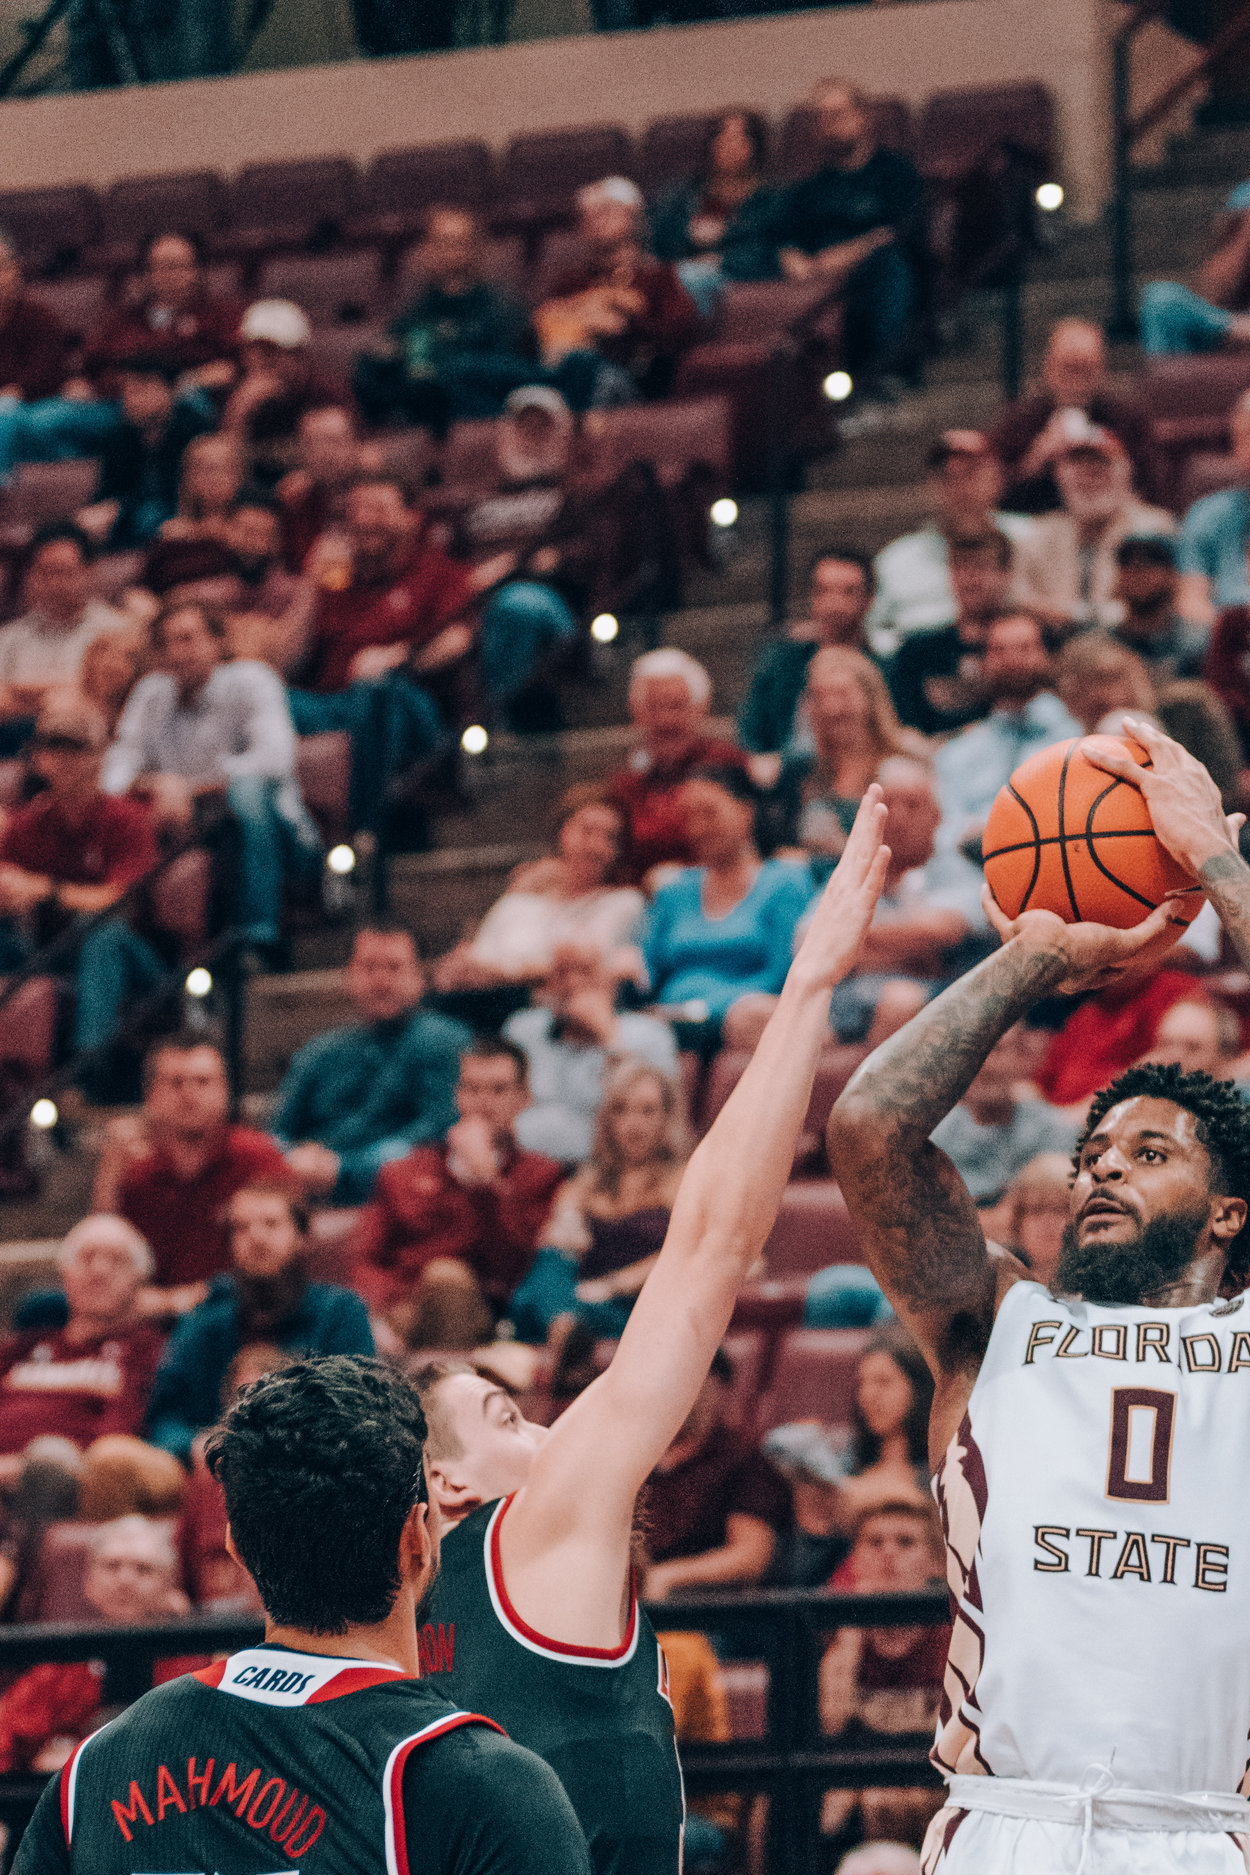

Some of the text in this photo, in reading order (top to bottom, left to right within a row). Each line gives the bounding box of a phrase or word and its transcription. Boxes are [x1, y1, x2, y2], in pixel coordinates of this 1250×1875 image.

[1104, 1385, 1178, 1505] 0
[1032, 1524, 1230, 1593] STATE
[232, 1665, 316, 1695] CARDS
[111, 1756, 327, 1859] MAHMOUD
